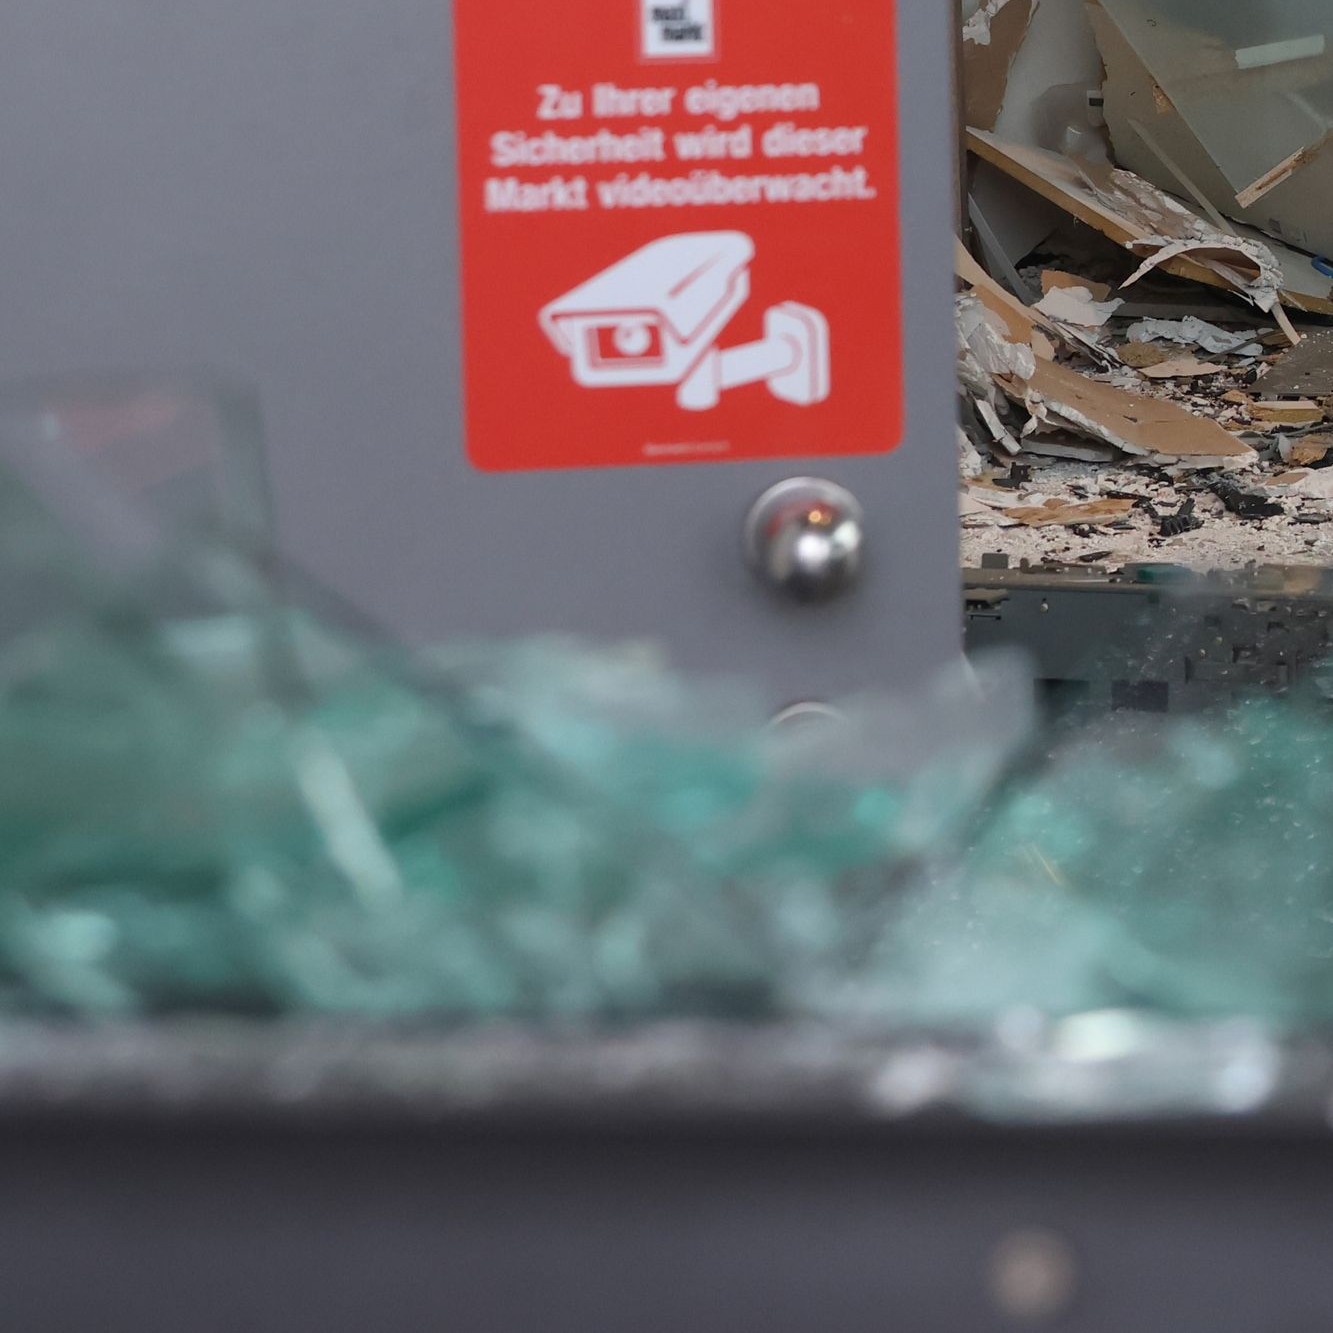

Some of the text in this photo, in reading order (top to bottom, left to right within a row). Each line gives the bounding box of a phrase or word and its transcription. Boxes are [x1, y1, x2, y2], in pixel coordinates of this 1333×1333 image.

[537, 79, 820, 121] Zu Ihrer eigenen
[490, 122, 868, 167] Sicherheit wird dieser
[484, 167, 876, 213] Markt videoüberwacht.
